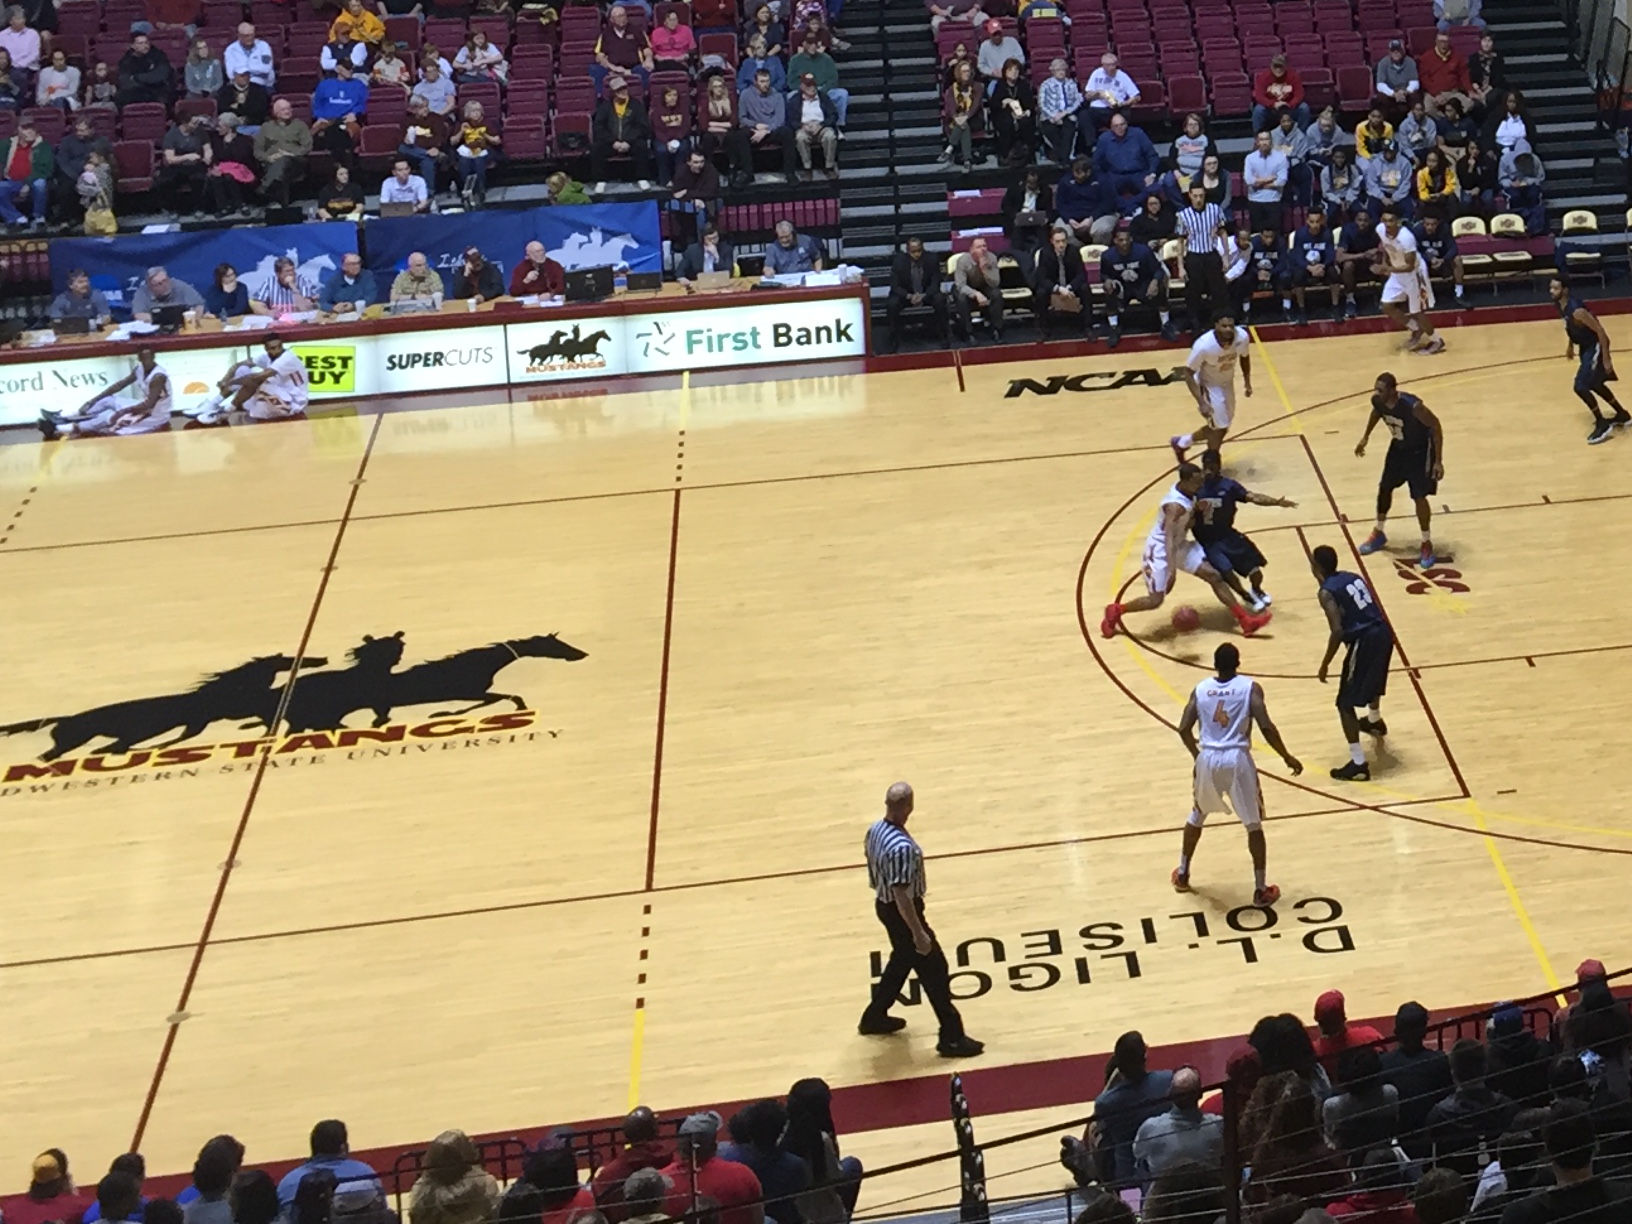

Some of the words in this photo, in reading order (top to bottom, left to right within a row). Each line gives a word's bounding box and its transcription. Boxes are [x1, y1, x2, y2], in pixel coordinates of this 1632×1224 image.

[685, 324, 761, 355] First
[772, 318, 854, 348] Bank
[297, 355, 353, 369] EST
[385, 346, 494, 372] SUPERCUTS
[524, 360, 607, 374] MUSTANGS
[52, 369, 109, 389] News
[307, 370, 347, 385] UY
[1346, 577, 1373, 610] 23
[1212, 699, 1231, 729] 4
[2, 710, 540, 782] MUSTANGS
[219, 754, 327, 775] STATE
[347, 728, 564, 761] UNIVERSITY
[870, 896, 1344, 977] COLISEU
